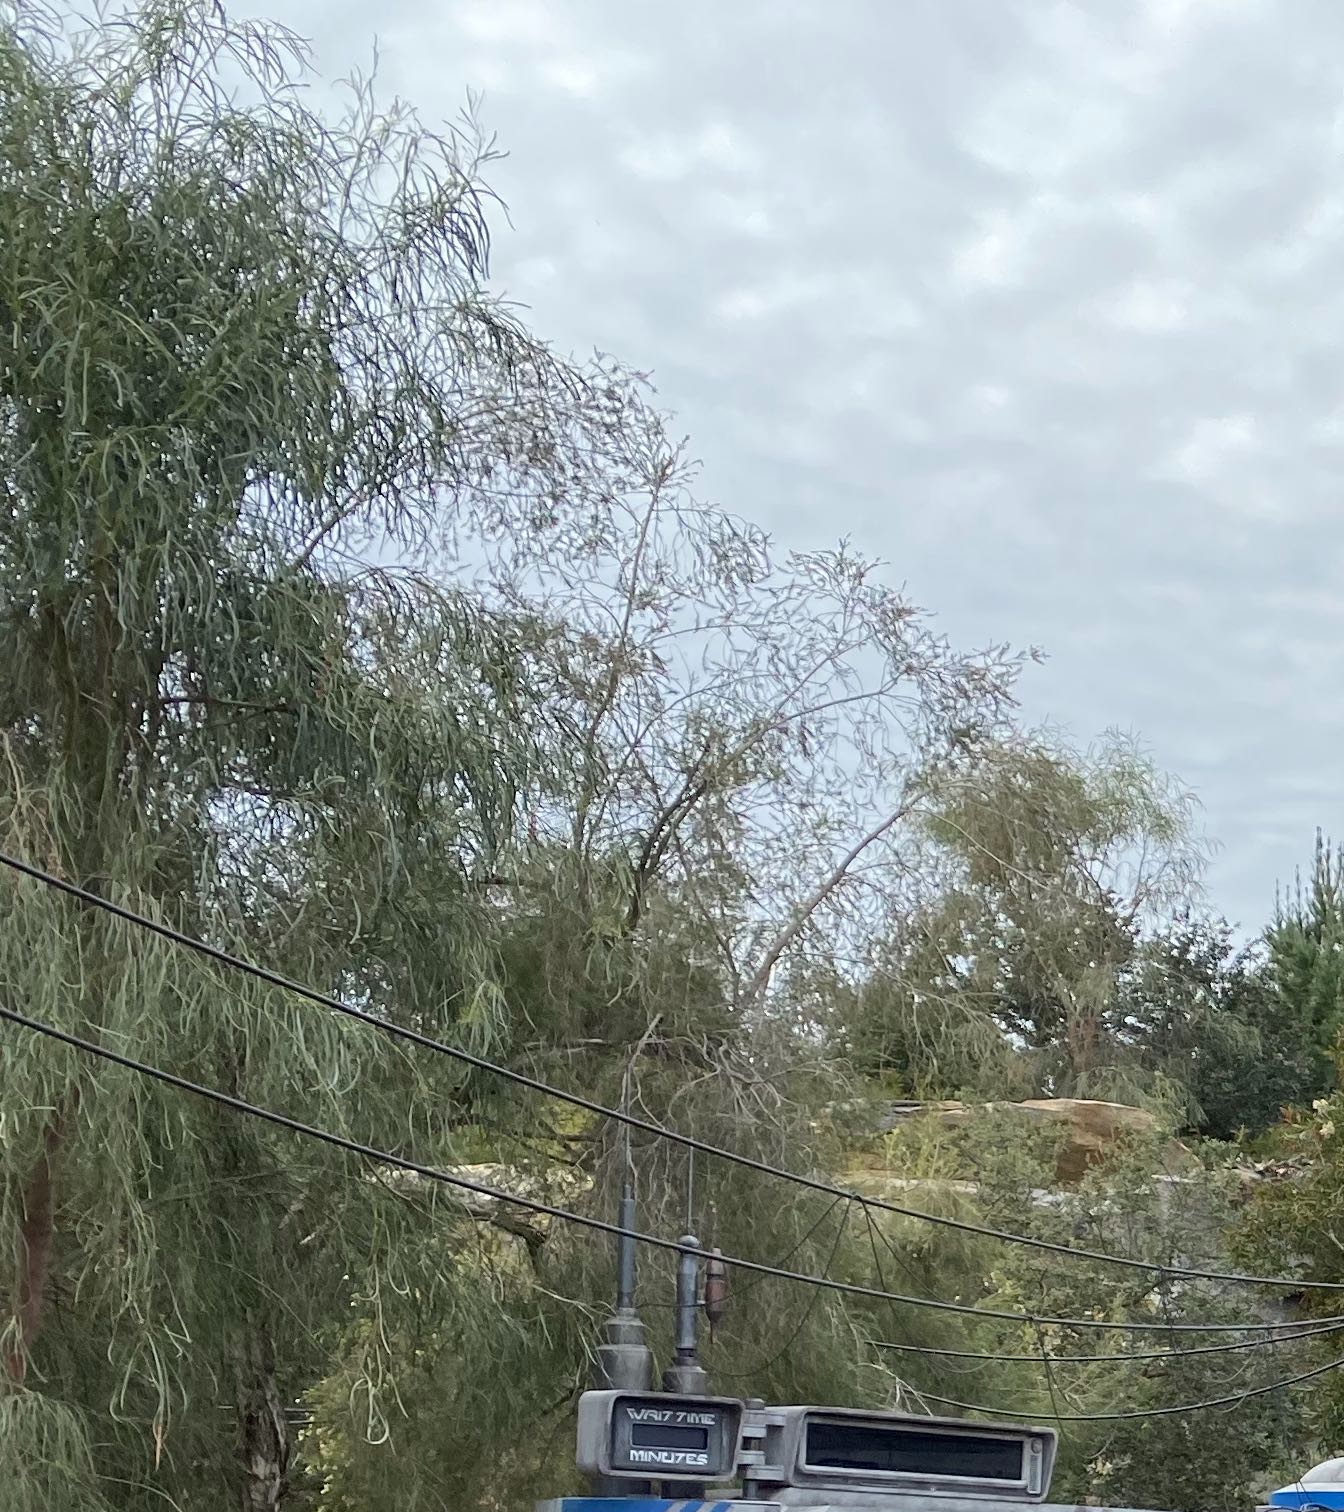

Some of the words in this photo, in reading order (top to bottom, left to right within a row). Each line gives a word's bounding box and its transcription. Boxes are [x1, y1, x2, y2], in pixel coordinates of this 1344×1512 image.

[626, 1408, 674, 1421] WAIT
[676, 1411, 716, 1425] TIME
[629, 1449, 709, 1466] MINUTES
